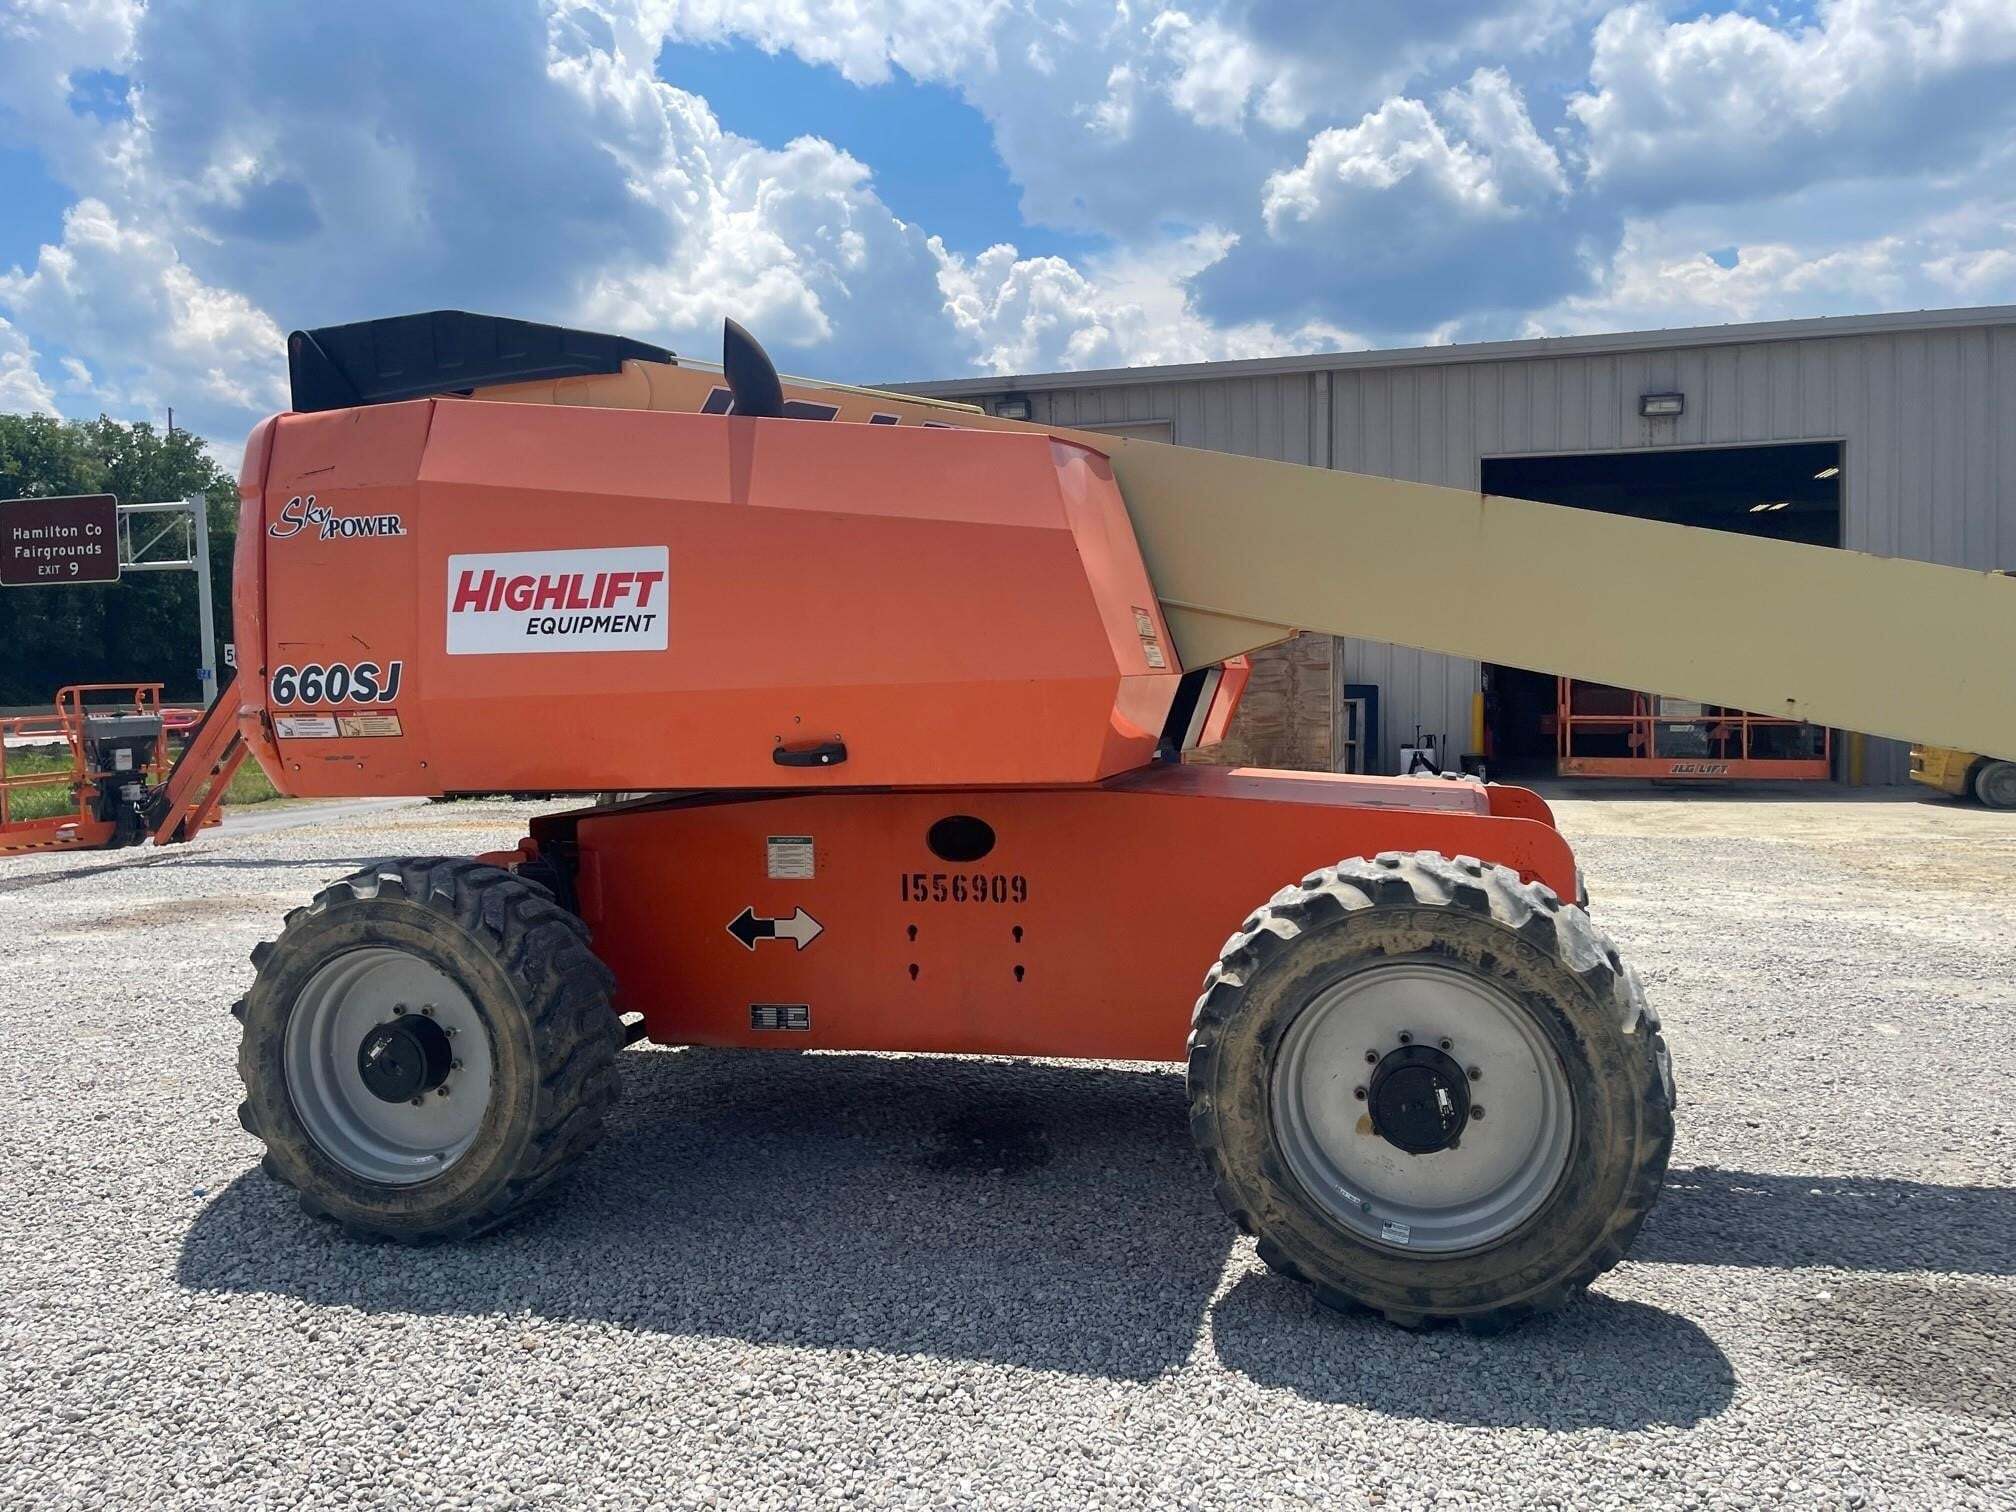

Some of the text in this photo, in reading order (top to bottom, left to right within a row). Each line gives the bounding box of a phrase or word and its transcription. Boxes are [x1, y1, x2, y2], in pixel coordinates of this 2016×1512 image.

[269, 496, 401, 540] Sky POWER
[13, 523, 102, 540] Hamilton Co
[14, 542, 102, 561] Fairgrounds
[38, 562, 79, 576] EXIT 9
[526, 614, 656, 635] EQUIPMENT
[272, 661, 402, 706] 660SJ
[898, 872, 1028, 904] 1556909
